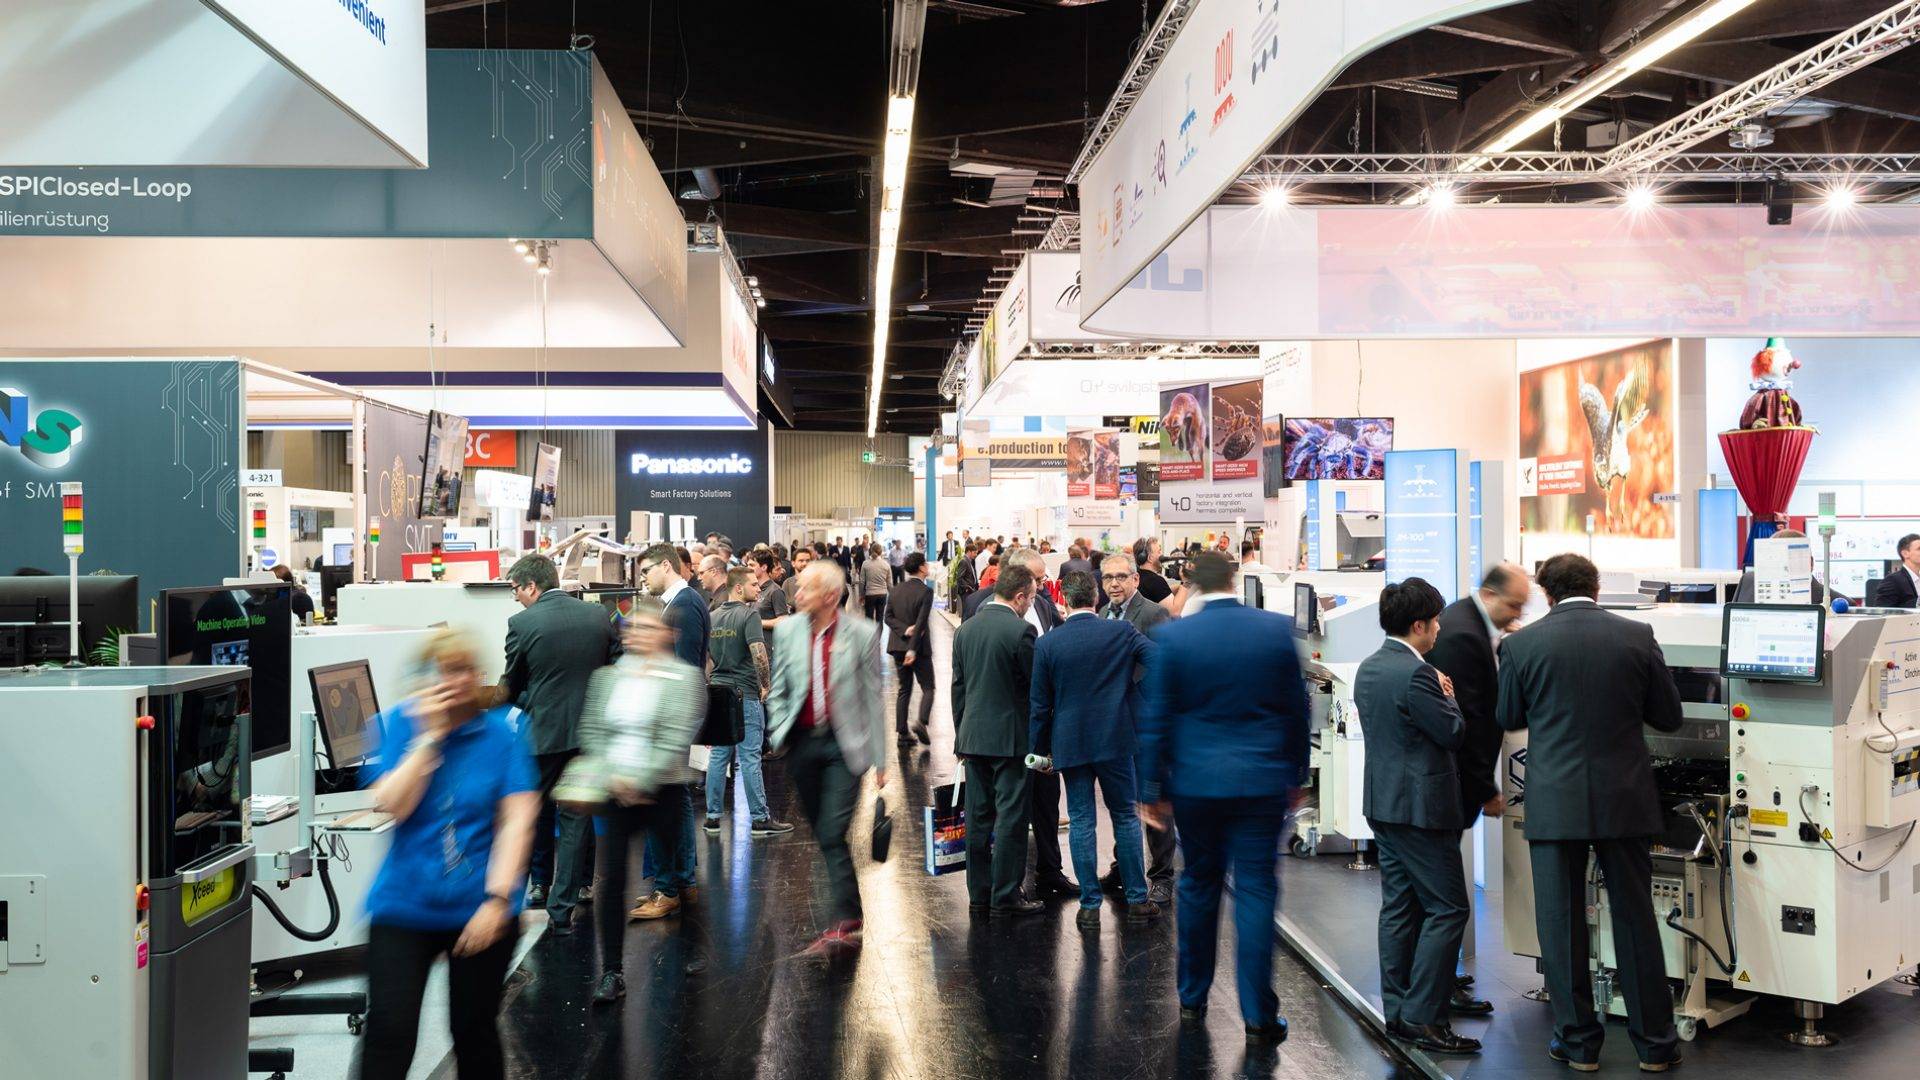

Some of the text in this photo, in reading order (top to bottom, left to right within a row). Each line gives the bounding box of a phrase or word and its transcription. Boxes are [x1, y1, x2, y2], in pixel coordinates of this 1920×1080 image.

[631, 453, 752, 474] Panasonic
[249, 474, 273, 483] 4-321
[650, 488, 732, 500] Smart Factory Solutions
[197, 614, 266, 631] Machine Operating Video
